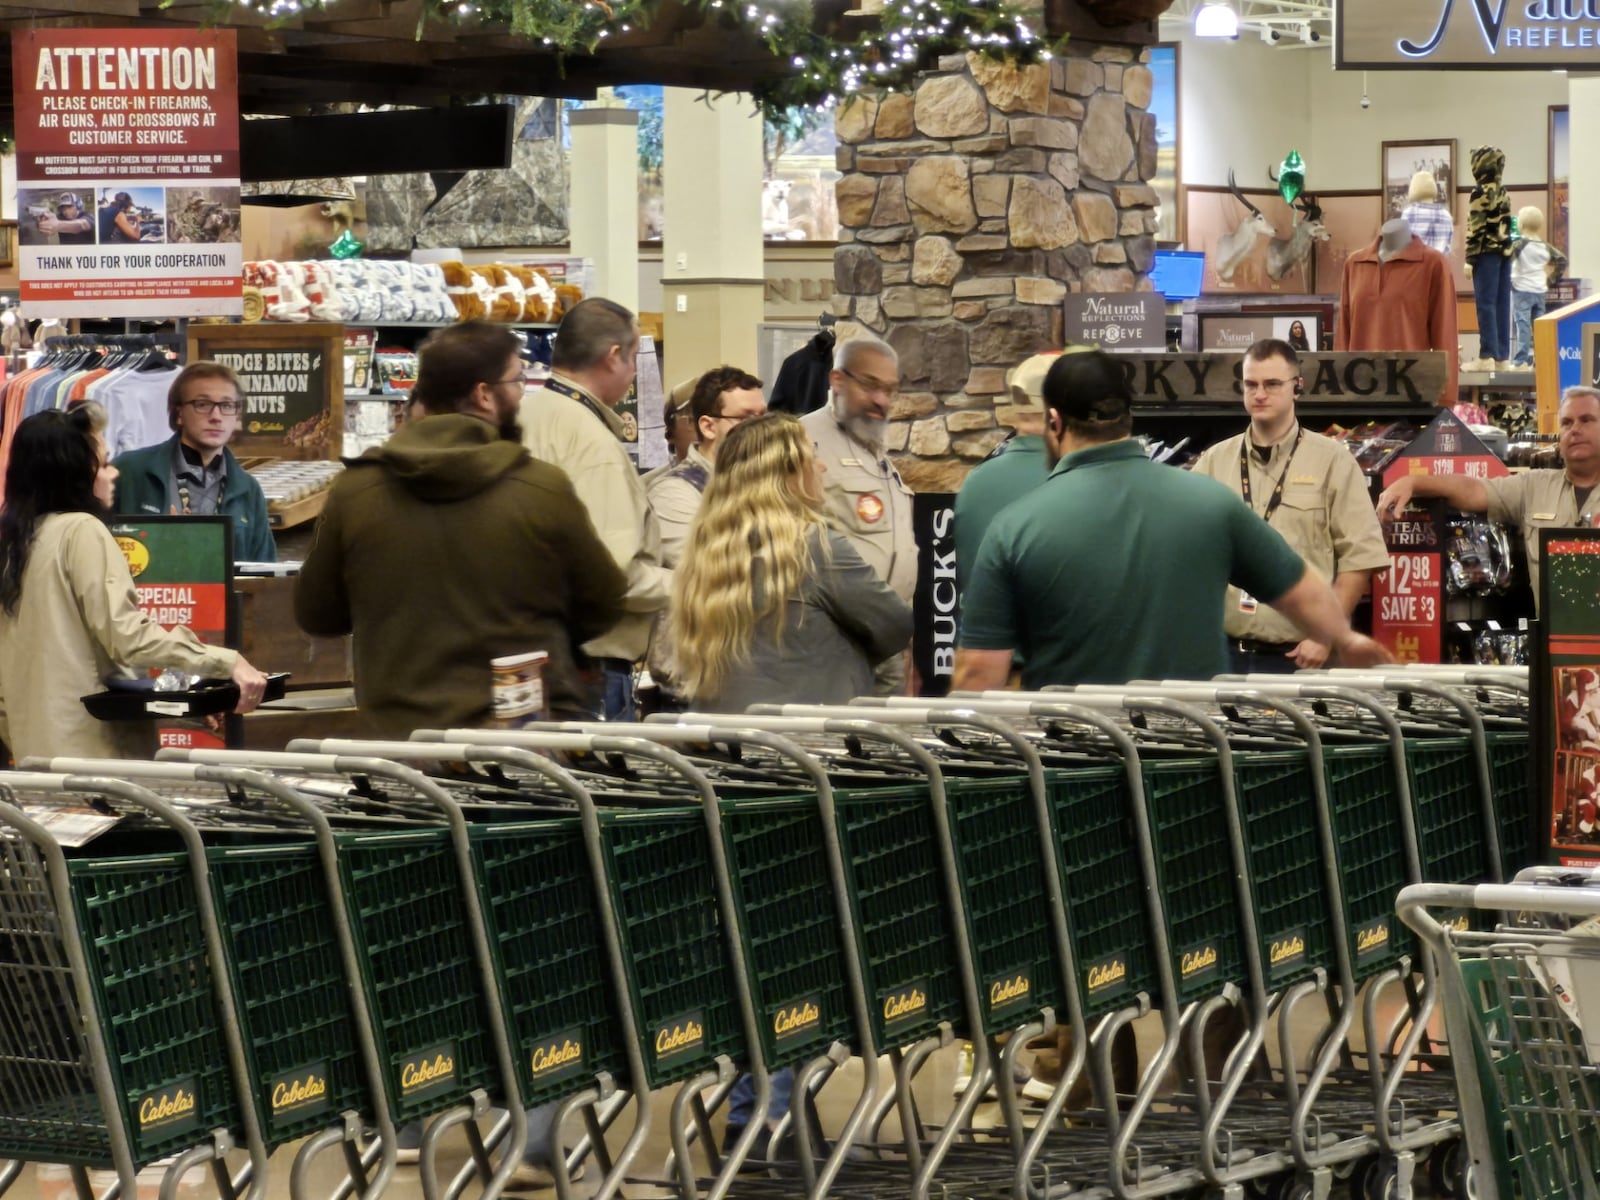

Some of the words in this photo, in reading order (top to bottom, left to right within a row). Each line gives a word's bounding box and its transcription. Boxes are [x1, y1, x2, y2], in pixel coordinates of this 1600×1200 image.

[1506, 27, 1600, 47] REFLE
[35, 47, 216, 90] ATTENTION
[43, 96, 87, 111] PLEASE
[90, 96, 146, 110] CHECK-IN
[150, 95, 212, 111] FIREARMS,
[39, 113, 59, 128] AIR
[62, 113, 98, 129] GUNS,
[102, 113, 125, 127] AND
[129, 112, 199, 127] CROSSBOWS
[203, 112, 216, 126] AT
[69, 130, 132, 144] CUSTOMER
[136, 129, 188, 144] SERVICE.
[36, 256, 72, 270] THANK
[76, 256, 97, 269] YOU
[101, 255, 120, 269] FOR
[124, 255, 151, 268] YOUR
[155, 254, 226, 268] COOPERATION
[1081, 298, 1146, 315] Natural
[266, 352, 310, 371] BITES
[1119, 360, 1212, 402] RKY
[246, 395, 286, 414] NUTS
[136, 587, 197, 605] SPECIAL
[932, 507, 957, 677] BUCK'S
[1381, 596, 1417, 621] SAVE
[1421, 595, 1435, 622] $3
[160, 733, 192, 746] FER!
